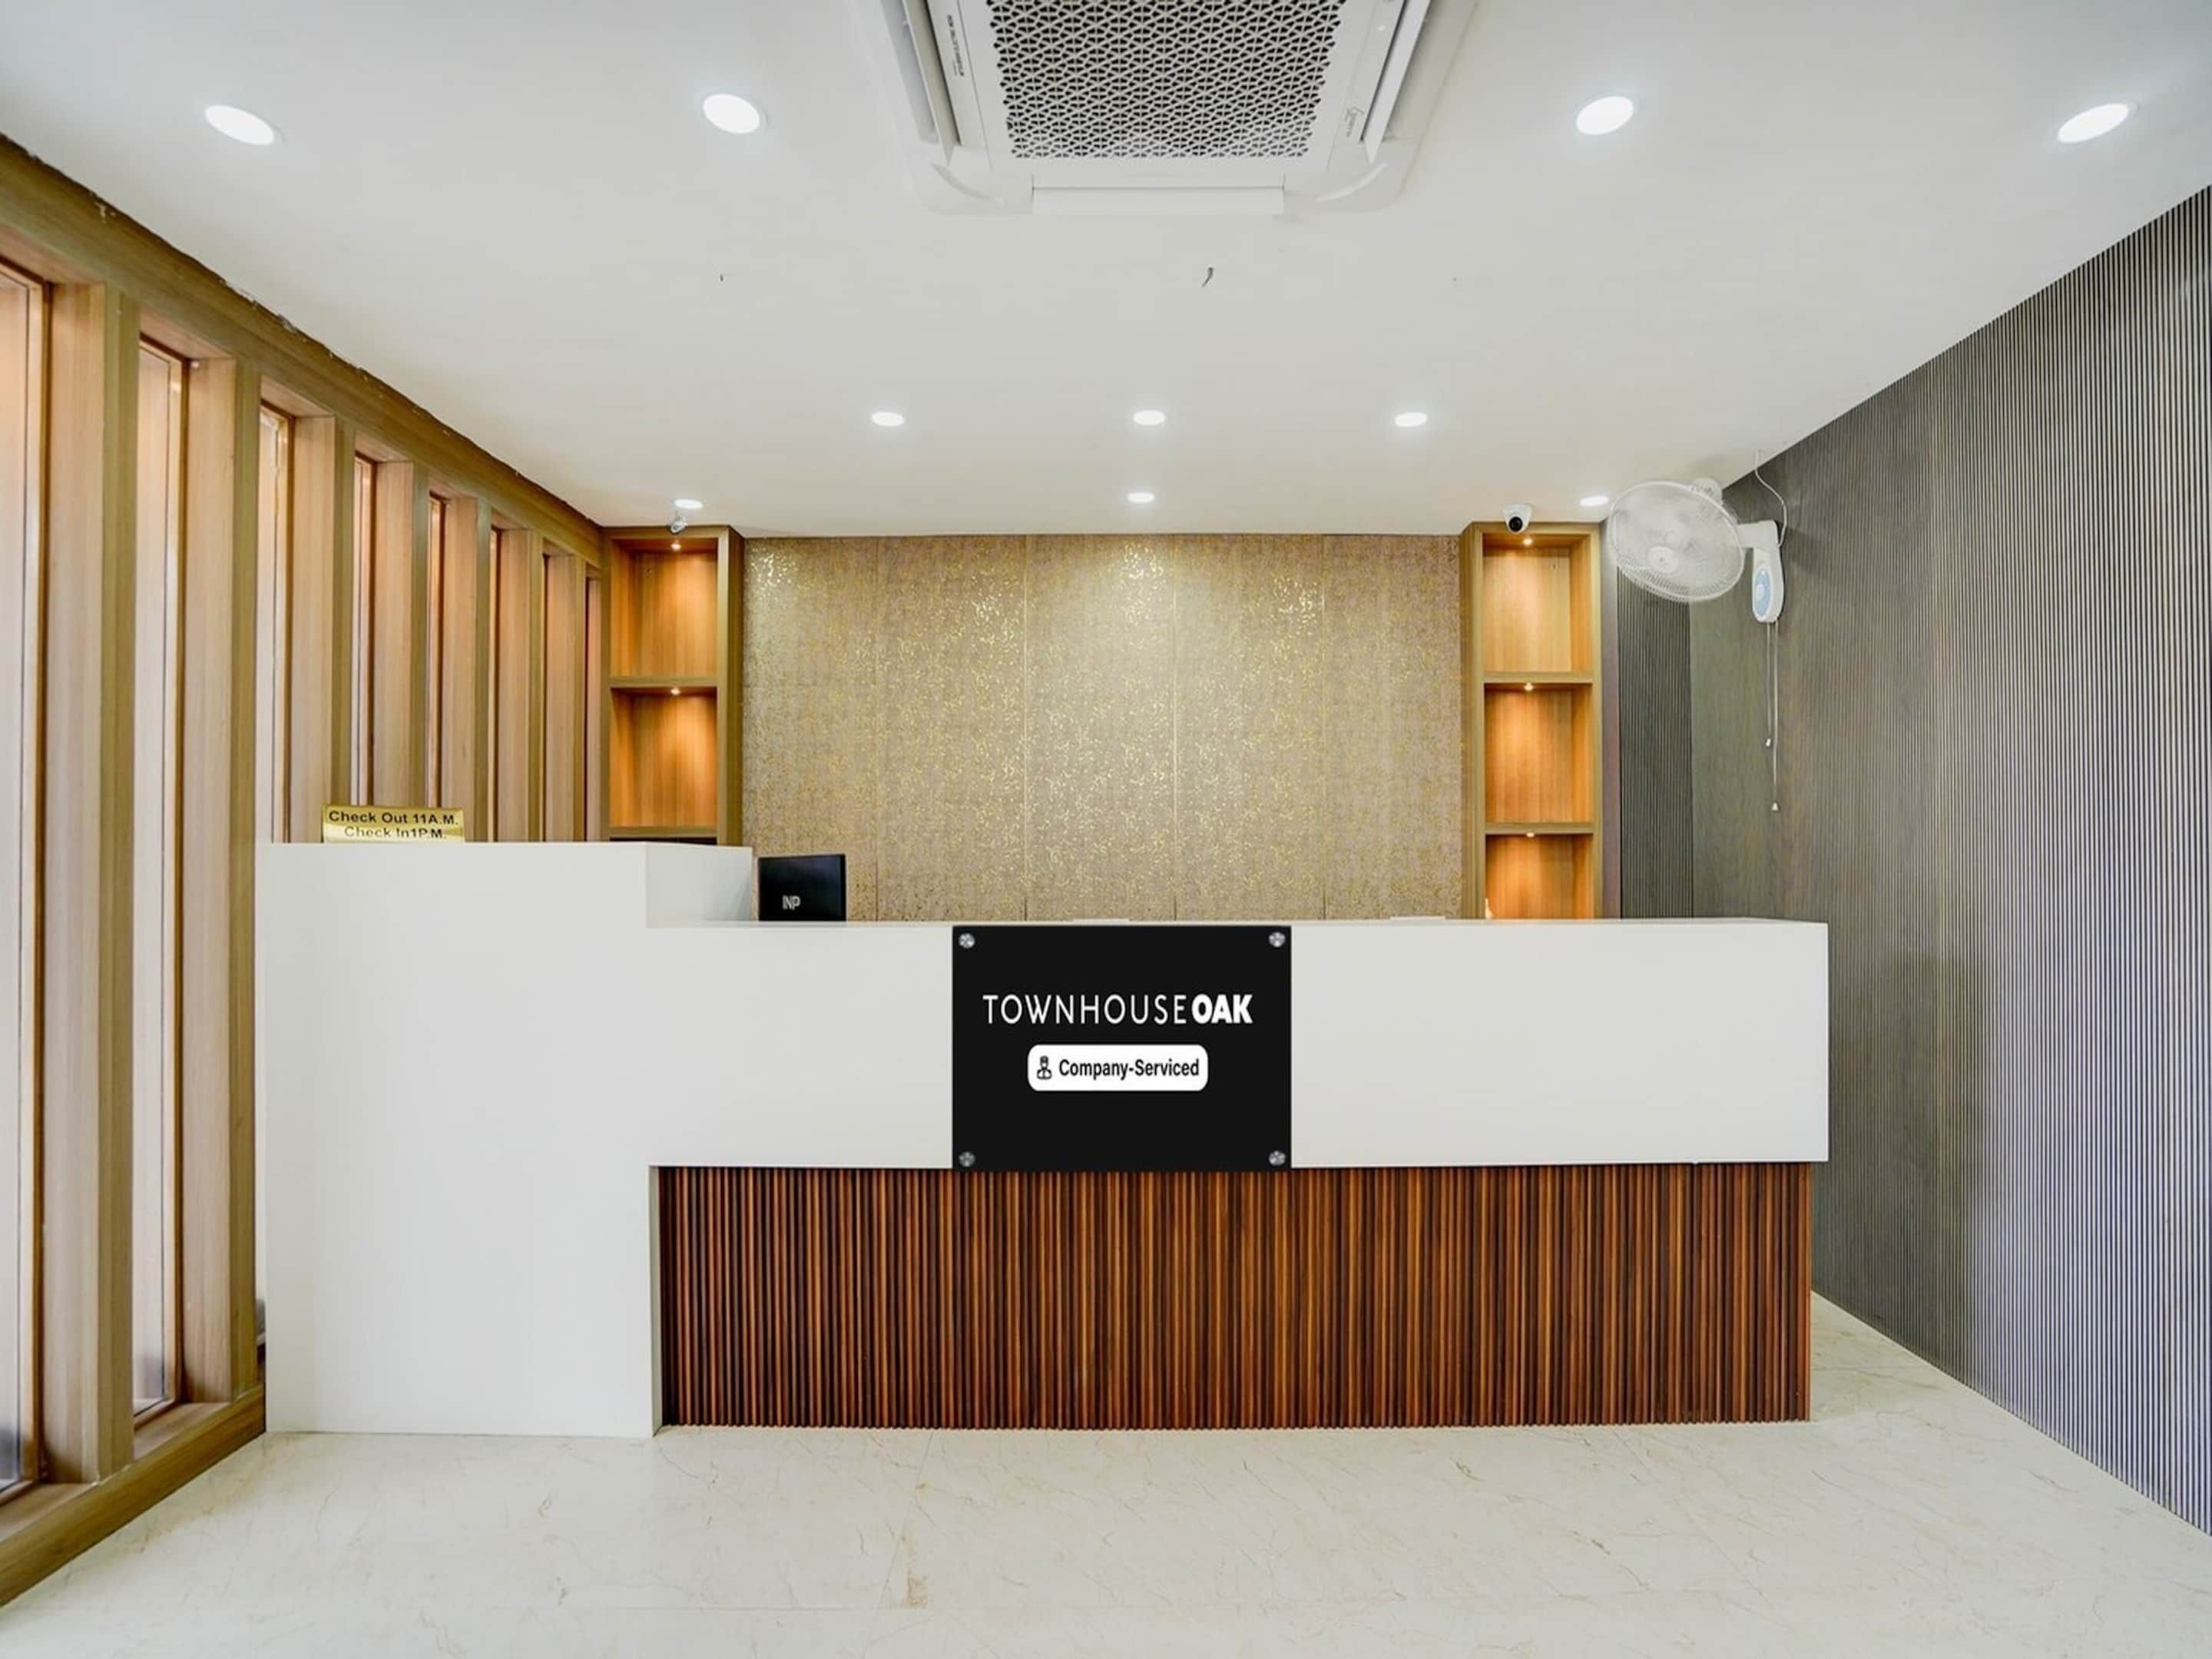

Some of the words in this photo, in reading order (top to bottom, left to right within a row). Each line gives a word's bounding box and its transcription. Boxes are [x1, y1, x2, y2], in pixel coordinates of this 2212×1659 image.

[329, 810, 376, 823] Check
[381, 811, 408, 824] Out
[344, 826, 392, 838] Check
[1058, 1058, 1200, 1081] Company-Serviced
